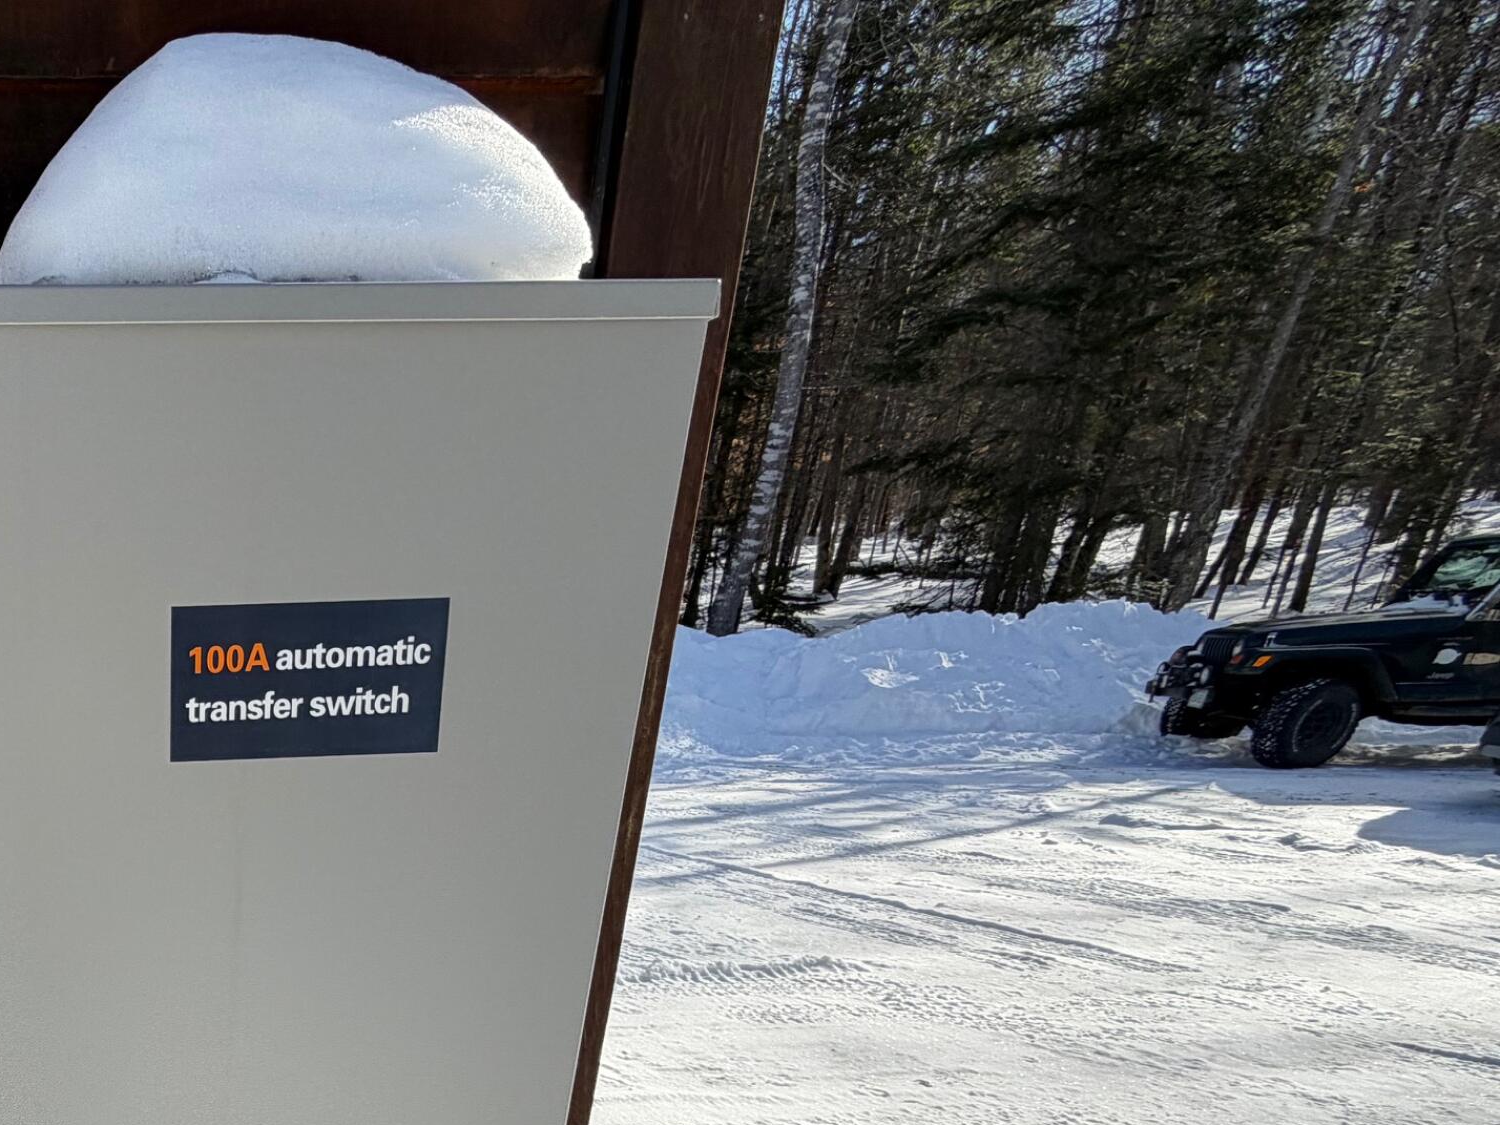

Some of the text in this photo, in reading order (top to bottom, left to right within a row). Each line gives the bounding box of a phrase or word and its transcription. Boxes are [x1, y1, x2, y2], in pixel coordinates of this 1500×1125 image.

[188, 636, 432, 674] 100A automatic
[186, 686, 410, 723] transfer switch
